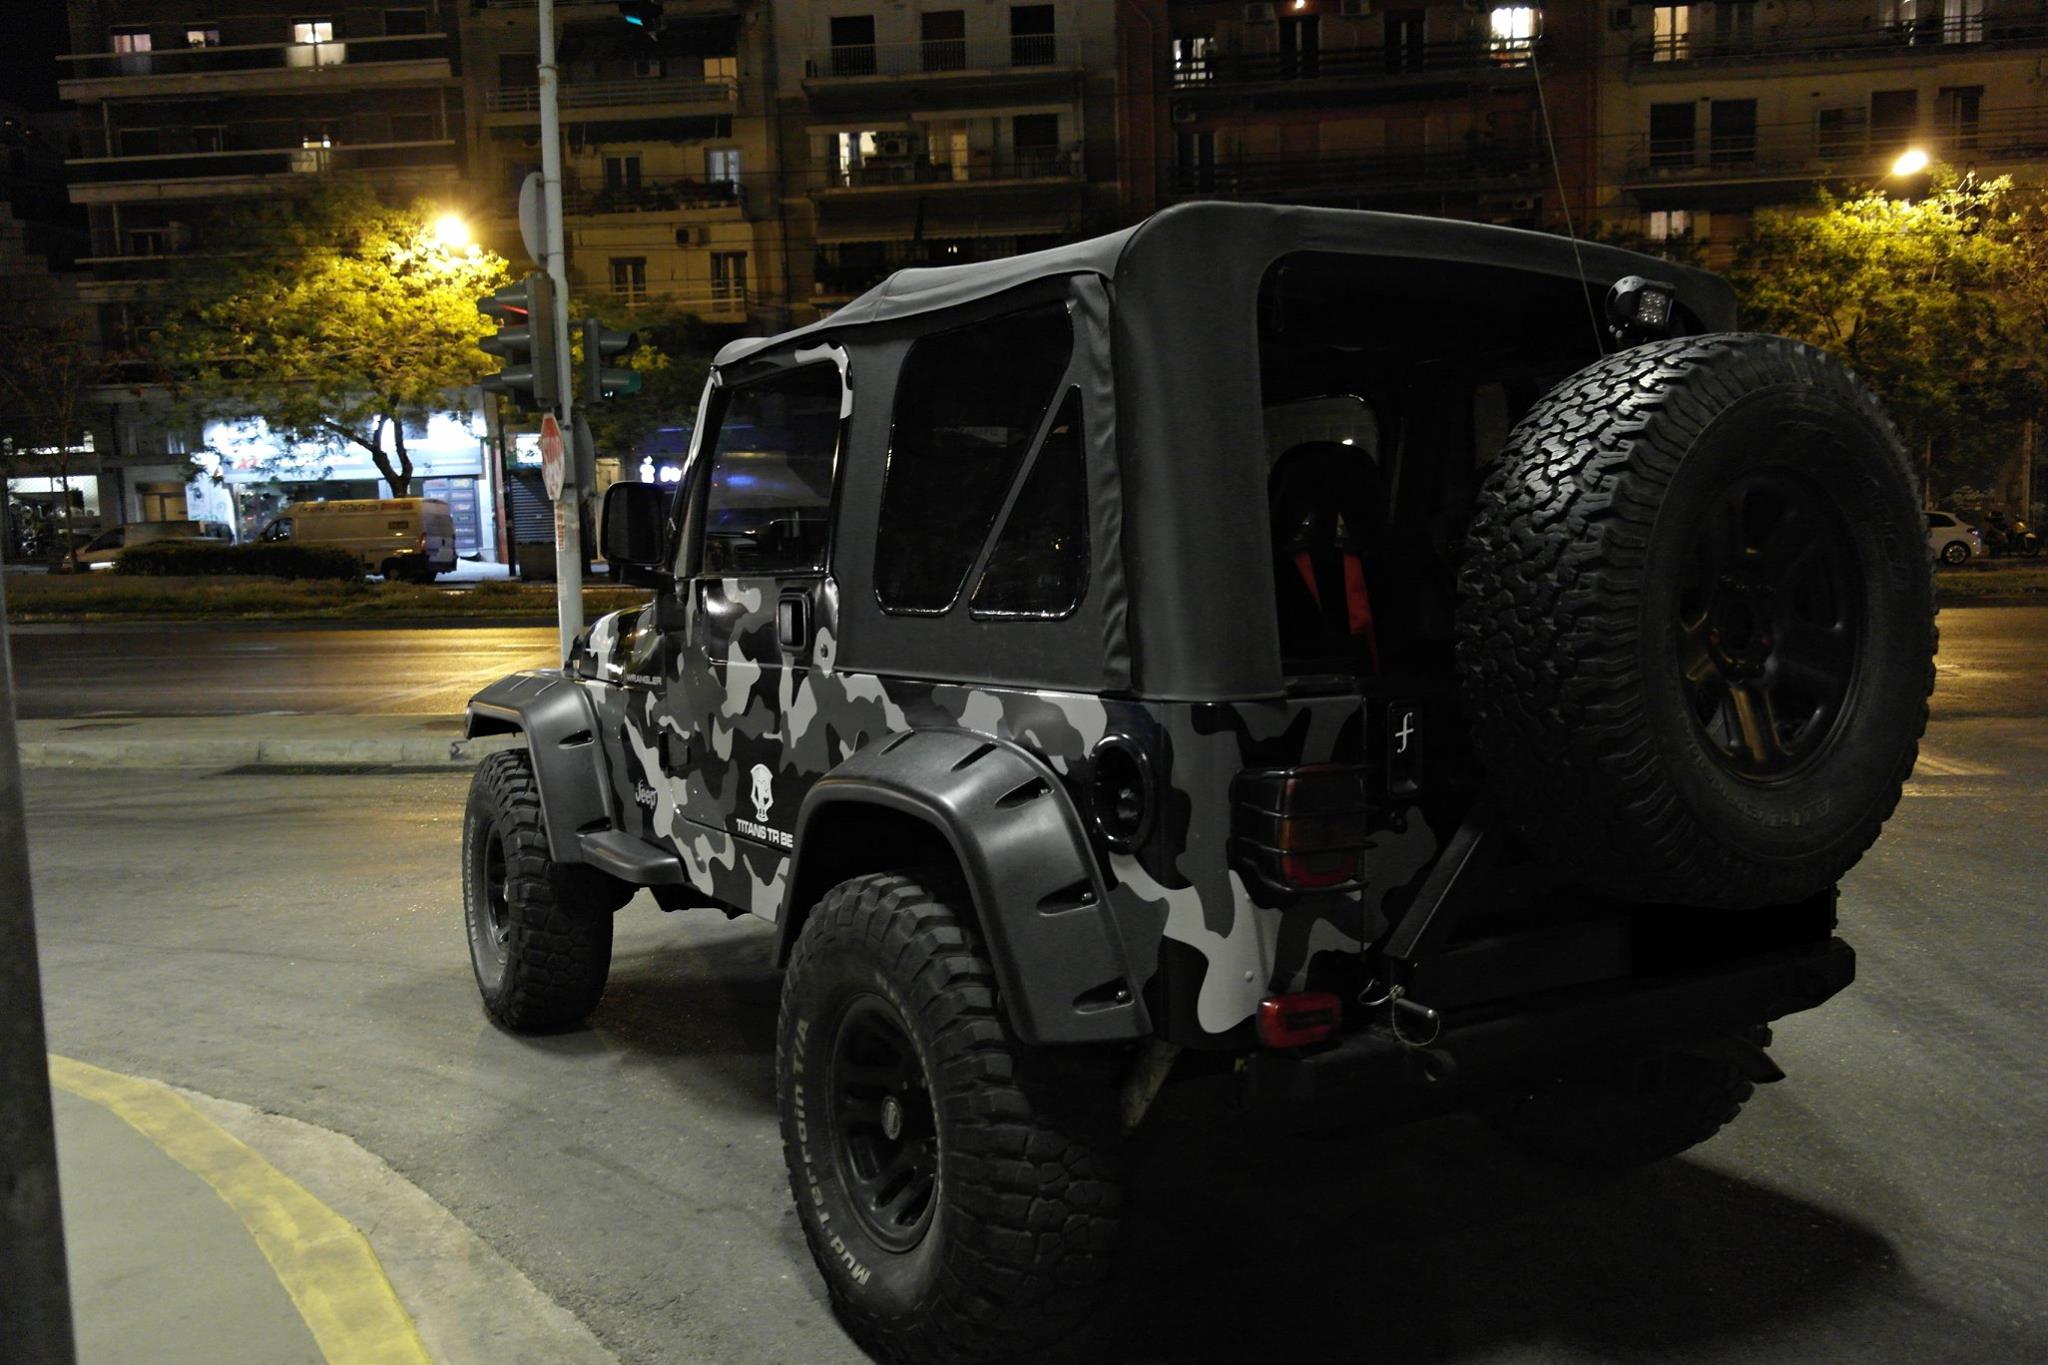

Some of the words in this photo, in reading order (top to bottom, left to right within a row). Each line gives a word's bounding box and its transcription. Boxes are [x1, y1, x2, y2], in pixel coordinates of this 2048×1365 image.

[635, 779, 657, 810] Jeep
[736, 818, 767, 840] TITANS
[793, 1018, 809, 1075] T/A
[794, 1084, 872, 1286] Mud-Terrain
